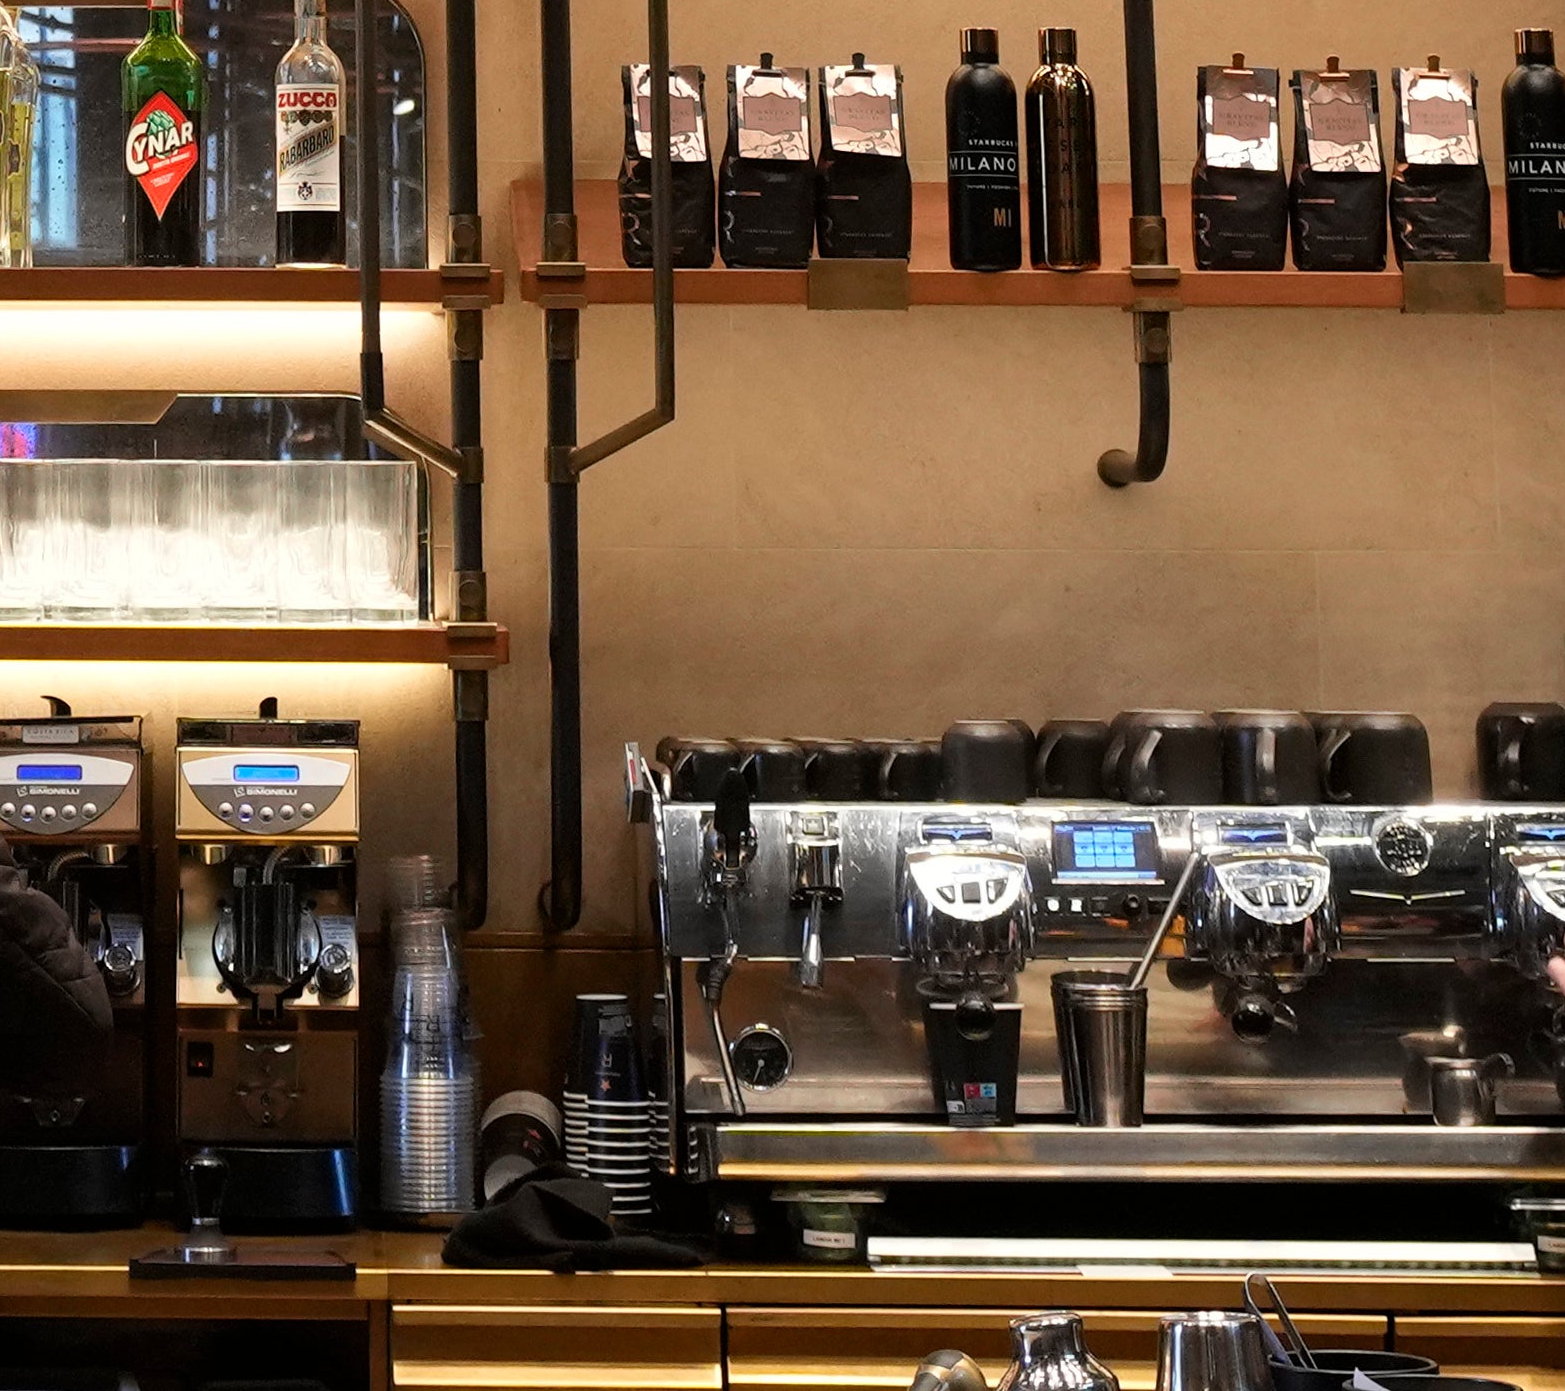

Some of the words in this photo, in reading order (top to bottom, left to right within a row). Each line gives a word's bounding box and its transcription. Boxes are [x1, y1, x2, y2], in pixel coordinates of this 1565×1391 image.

[277, 91, 338, 108] ZUCCA
[279, 124, 335, 172] RABARBARO
[949, 156, 1017, 172] MILANO
